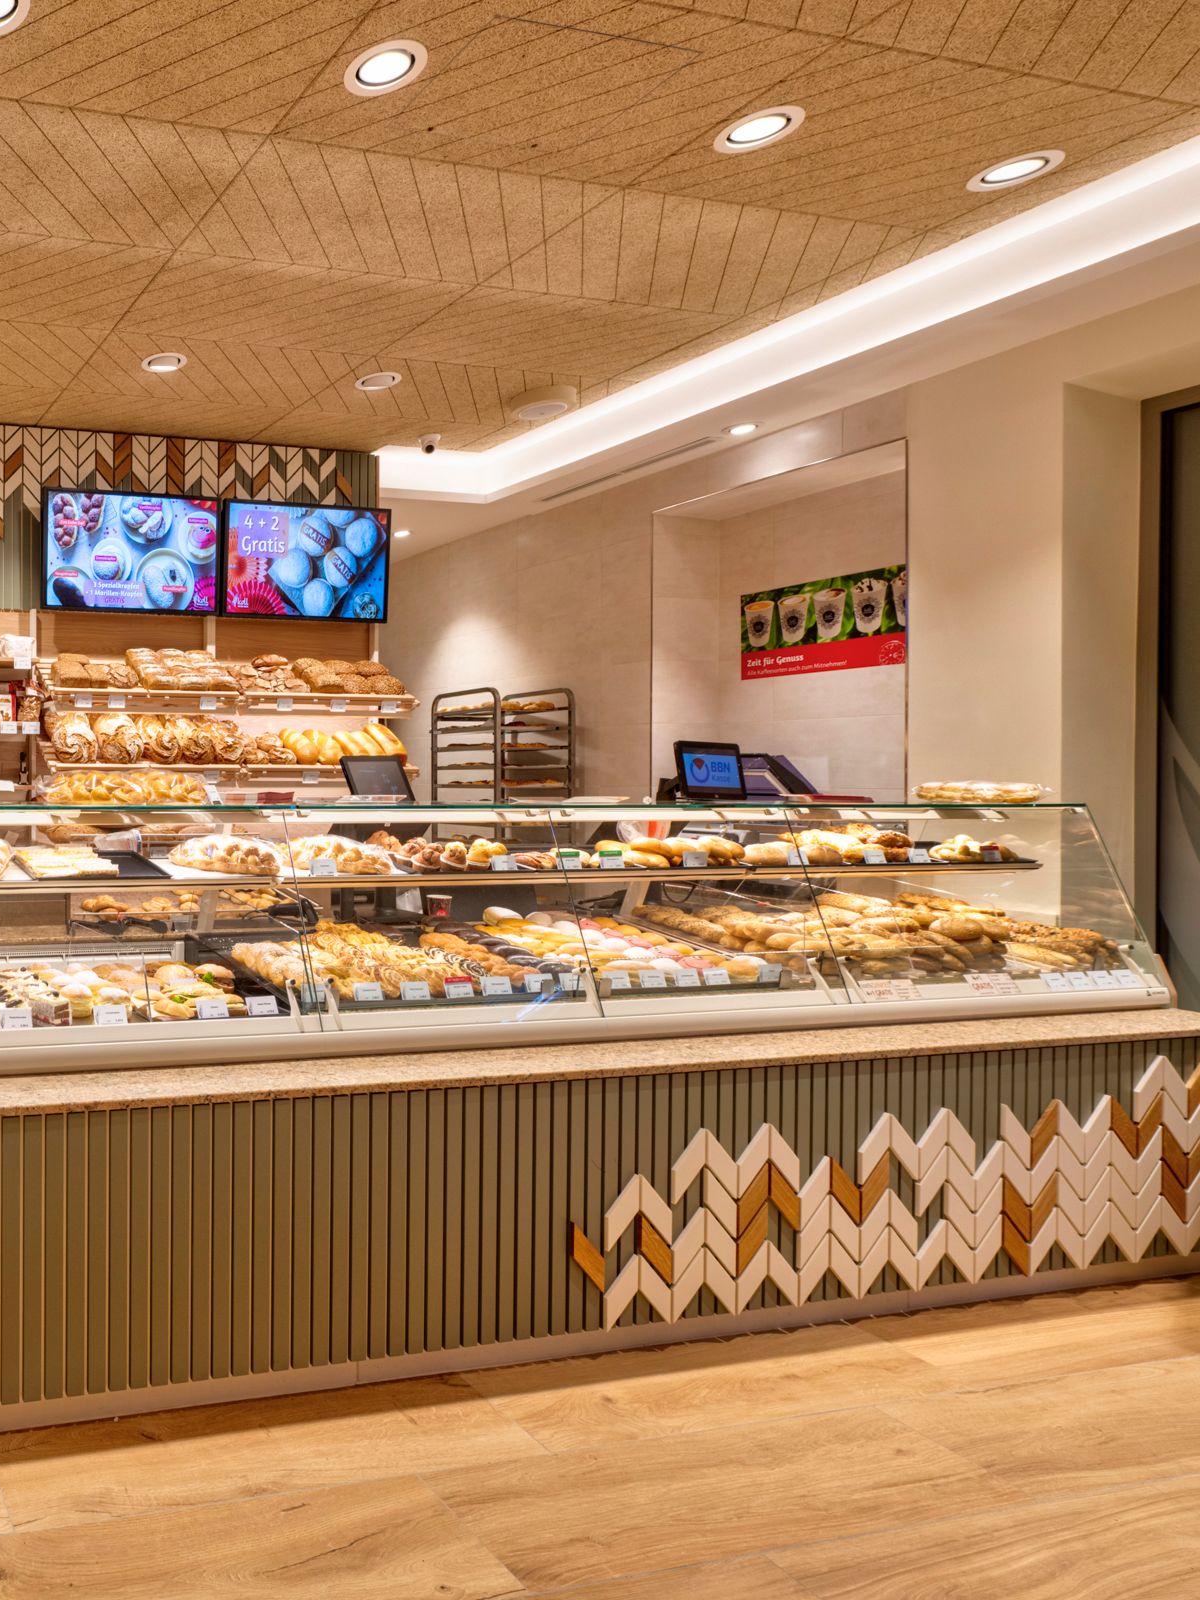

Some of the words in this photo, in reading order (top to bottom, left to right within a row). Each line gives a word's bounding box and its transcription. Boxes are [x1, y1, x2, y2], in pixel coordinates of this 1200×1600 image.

[244, 514, 254, 529] 4
[258, 518, 267, 528] +
[271, 516, 280, 531] 2
[303, 525, 328, 546] GRATIS
[241, 535, 285, 556] Gratis
[331, 556, 353, 579] GRATIS
[747, 658, 761, 667] Zeit
[763, 656, 774, 667] für
[776, 654, 804, 665] Genuss
[813, 659, 848, 669] Mitnehmen!
